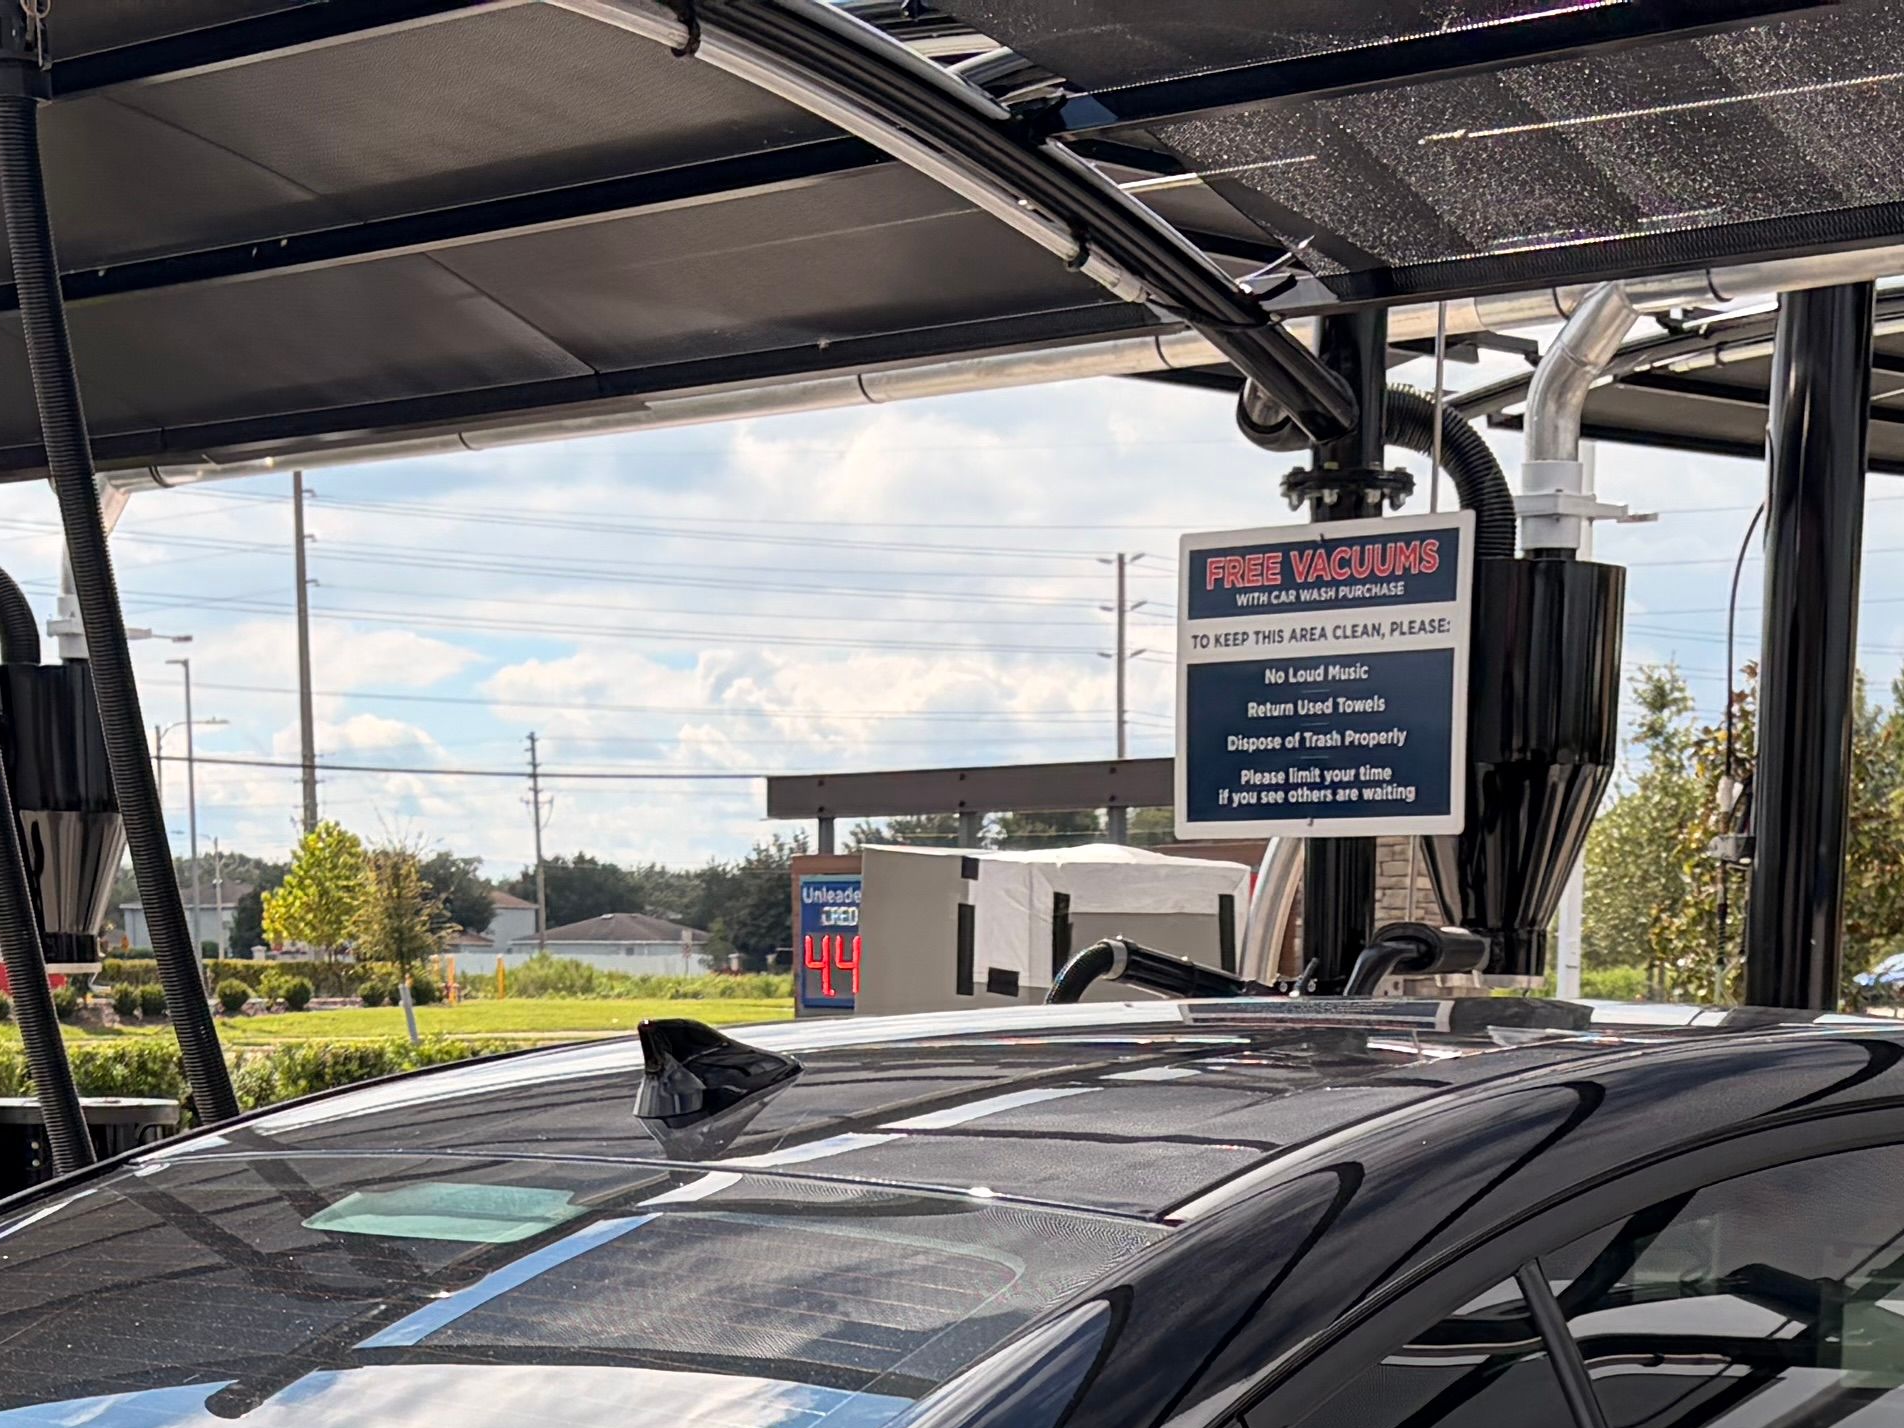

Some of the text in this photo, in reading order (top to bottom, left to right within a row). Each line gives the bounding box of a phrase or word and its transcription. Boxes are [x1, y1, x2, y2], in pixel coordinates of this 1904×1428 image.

[1206, 539, 1440, 590] FREE VACUUMS
[1236, 582, 1405, 606] WITH CAR WASH PURCHASE
[1191, 618, 1451, 649] TO KEEP THIS AREA CLEAN, PLEASE:
[1265, 662, 1369, 684] No Loud Music
[1247, 695, 1386, 718] Return Used Towels
[1227, 728, 1407, 753] Dispose of Trash Properly
[1240, 765, 1392, 787] Please limit your time
[1231, 789, 1258, 807] you
[1260, 789, 1285, 804] see
[1288, 786, 1332, 804] others
[1335, 787, 1359, 802] are
[1362, 783, 1416, 803] waiting
[803, 887, 862, 904] Unleade
[821, 906, 858, 926] CRED
